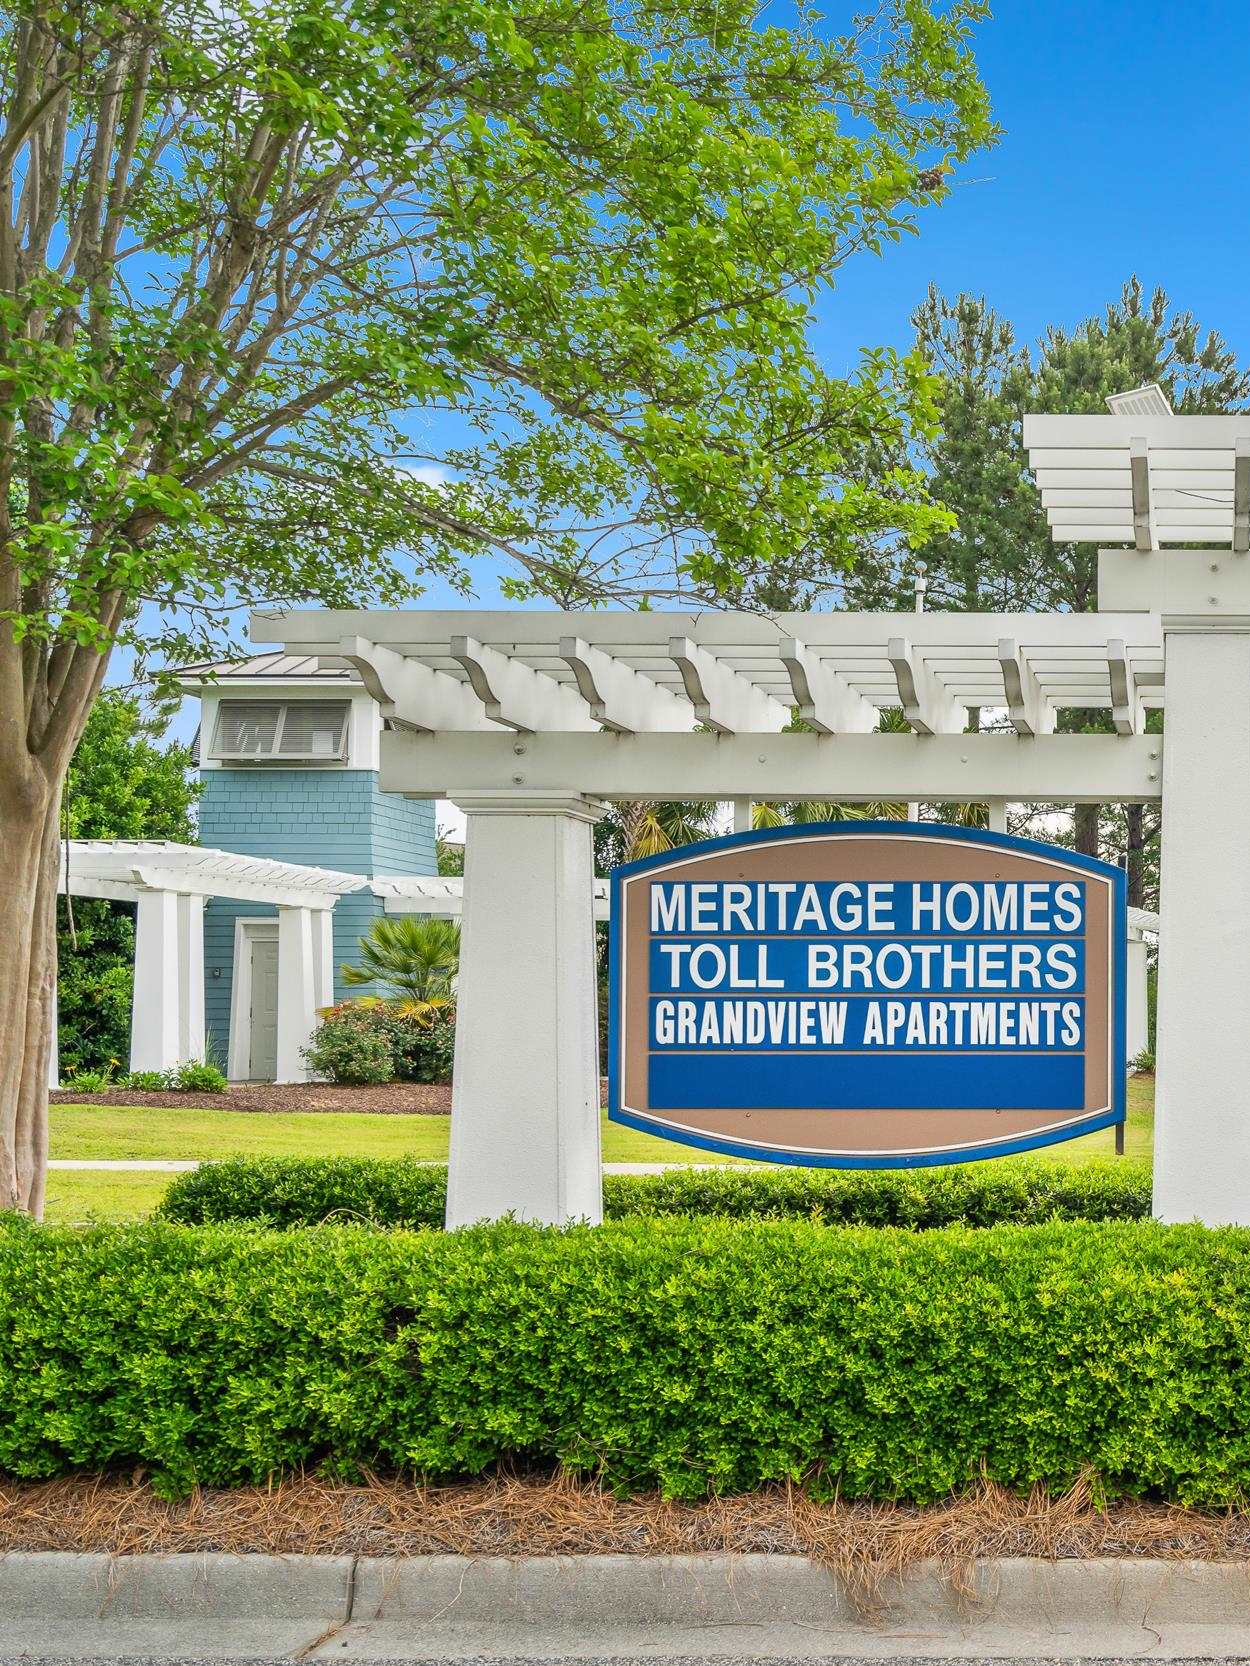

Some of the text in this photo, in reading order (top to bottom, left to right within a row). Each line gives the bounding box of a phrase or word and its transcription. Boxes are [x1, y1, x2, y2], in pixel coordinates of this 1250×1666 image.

[651, 882, 1082, 932] MERITAGE HOMES
[660, 943, 1078, 989] TOLL BROTHERS
[655, 1001, 1080, 1047] GRANDVIEW APARTMENTS
